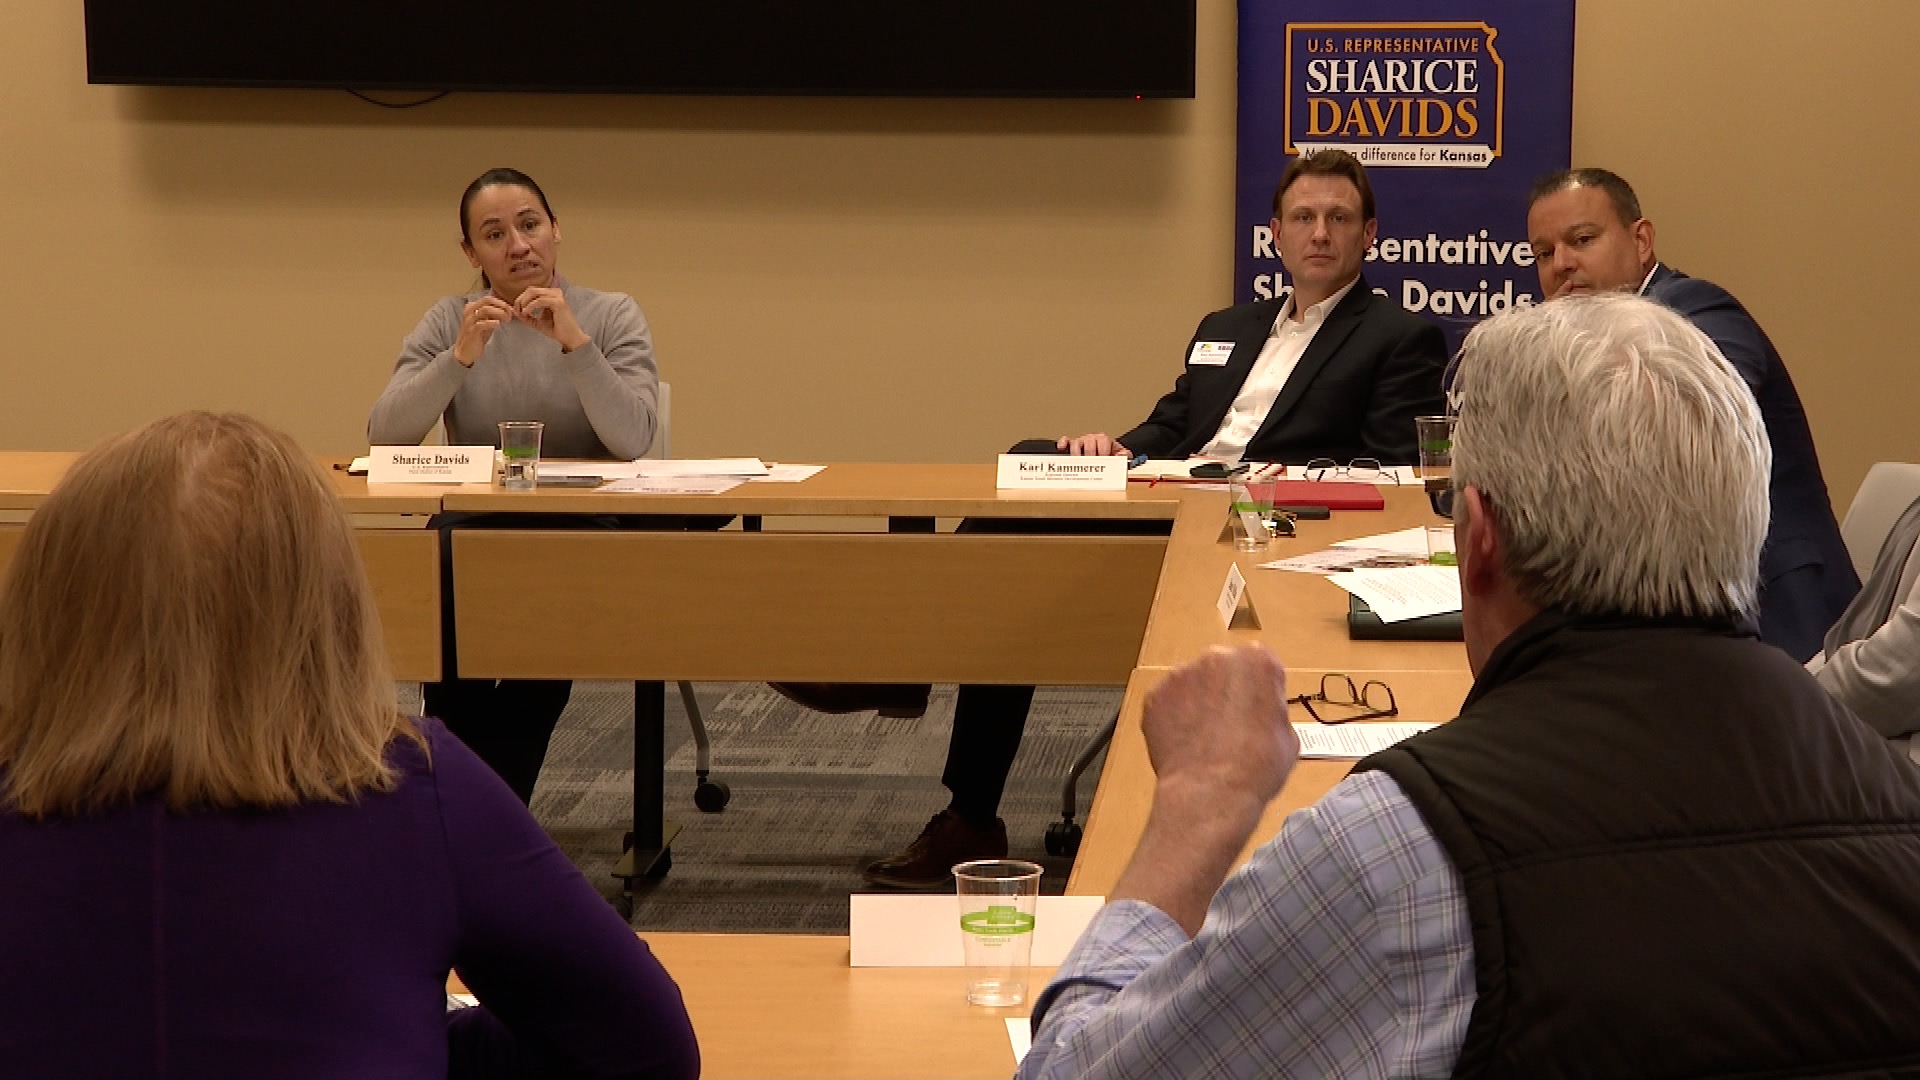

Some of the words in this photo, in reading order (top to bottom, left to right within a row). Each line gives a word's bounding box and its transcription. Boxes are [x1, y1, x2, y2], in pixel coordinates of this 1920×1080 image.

[1308, 38, 1338, 53] U.S.
[1344, 38, 1479, 54] REPRESENTATIVE
[1306, 59, 1479, 93] SHARICE
[1306, 97, 1479, 137] DAVIDS
[1361, 147, 1417, 161] difference
[1419, 147, 1436, 161] for
[1440, 149, 1487, 163] Kansas
[392, 454, 432, 465] Sharice
[434, 454, 470, 465] Davids
[1019, 462, 1044, 471] Karl
[1047, 463, 1106, 473] Kammerer
